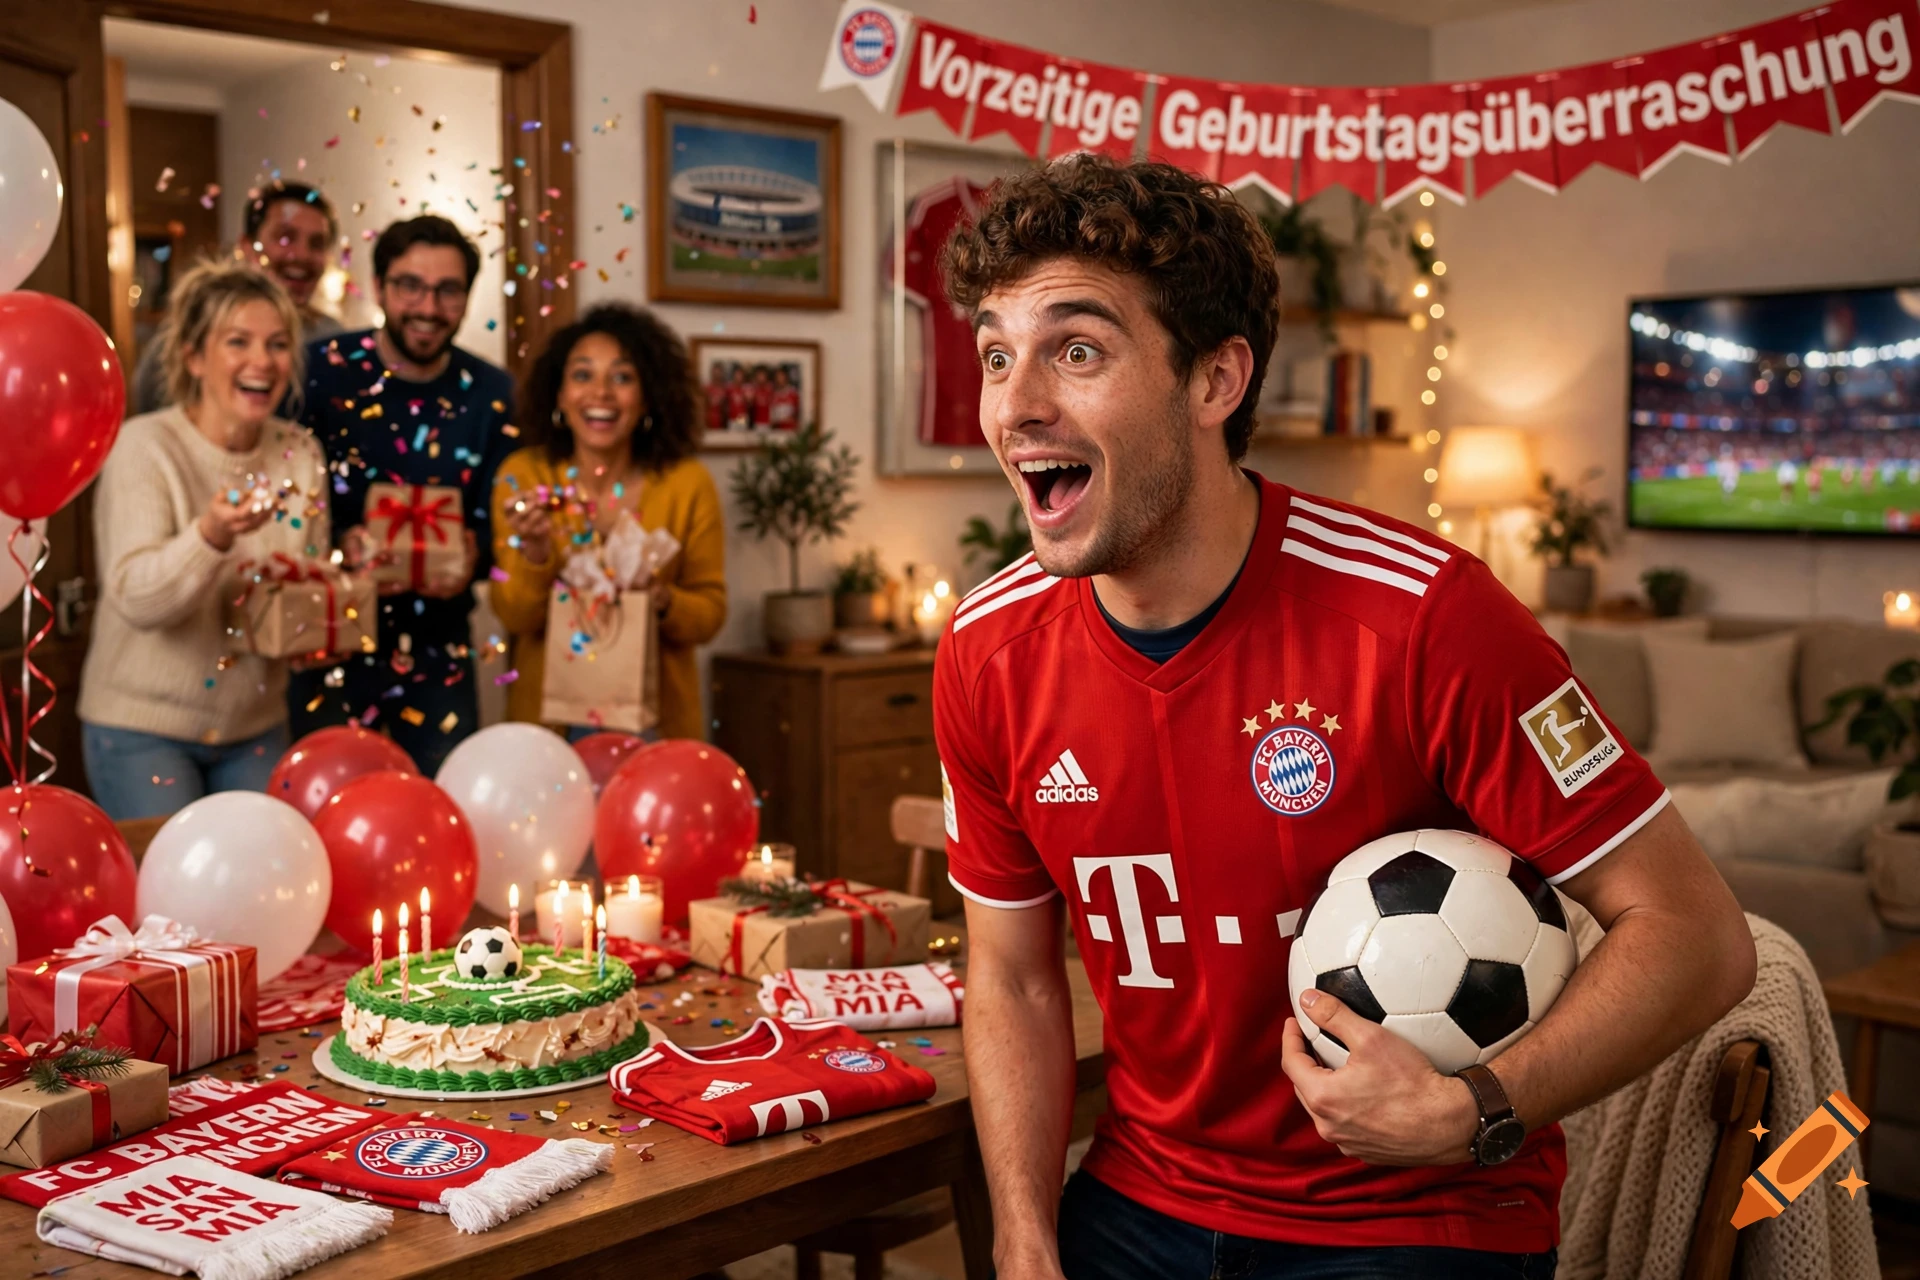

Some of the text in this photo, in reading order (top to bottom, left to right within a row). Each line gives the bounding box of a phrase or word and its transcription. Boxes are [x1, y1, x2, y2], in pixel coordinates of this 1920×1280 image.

[918, 30, 1141, 146] Vorzeitige
[1159, 12, 1912, 173] Geburtstagsüberraschung
[1257, 732, 1328, 767] FC BAYERN
[1035, 784, 1099, 803] adidas
[1072, 853, 1180, 989] T
[824, 981, 911, 996] SAN
[826, 971, 906, 983] MIA
[834, 993, 924, 1016] MIA
[18, 1160, 113, 1191] FC
[108, 1090, 326, 1165] BAYERN
[189, 1106, 373, 1167] NCHEN
[365, 1130, 447, 1168] FC BAYERN
[95, 1174, 218, 1218] MIA
[135, 1186, 256, 1232] SAN
[179, 1201, 301, 1243] MIA
